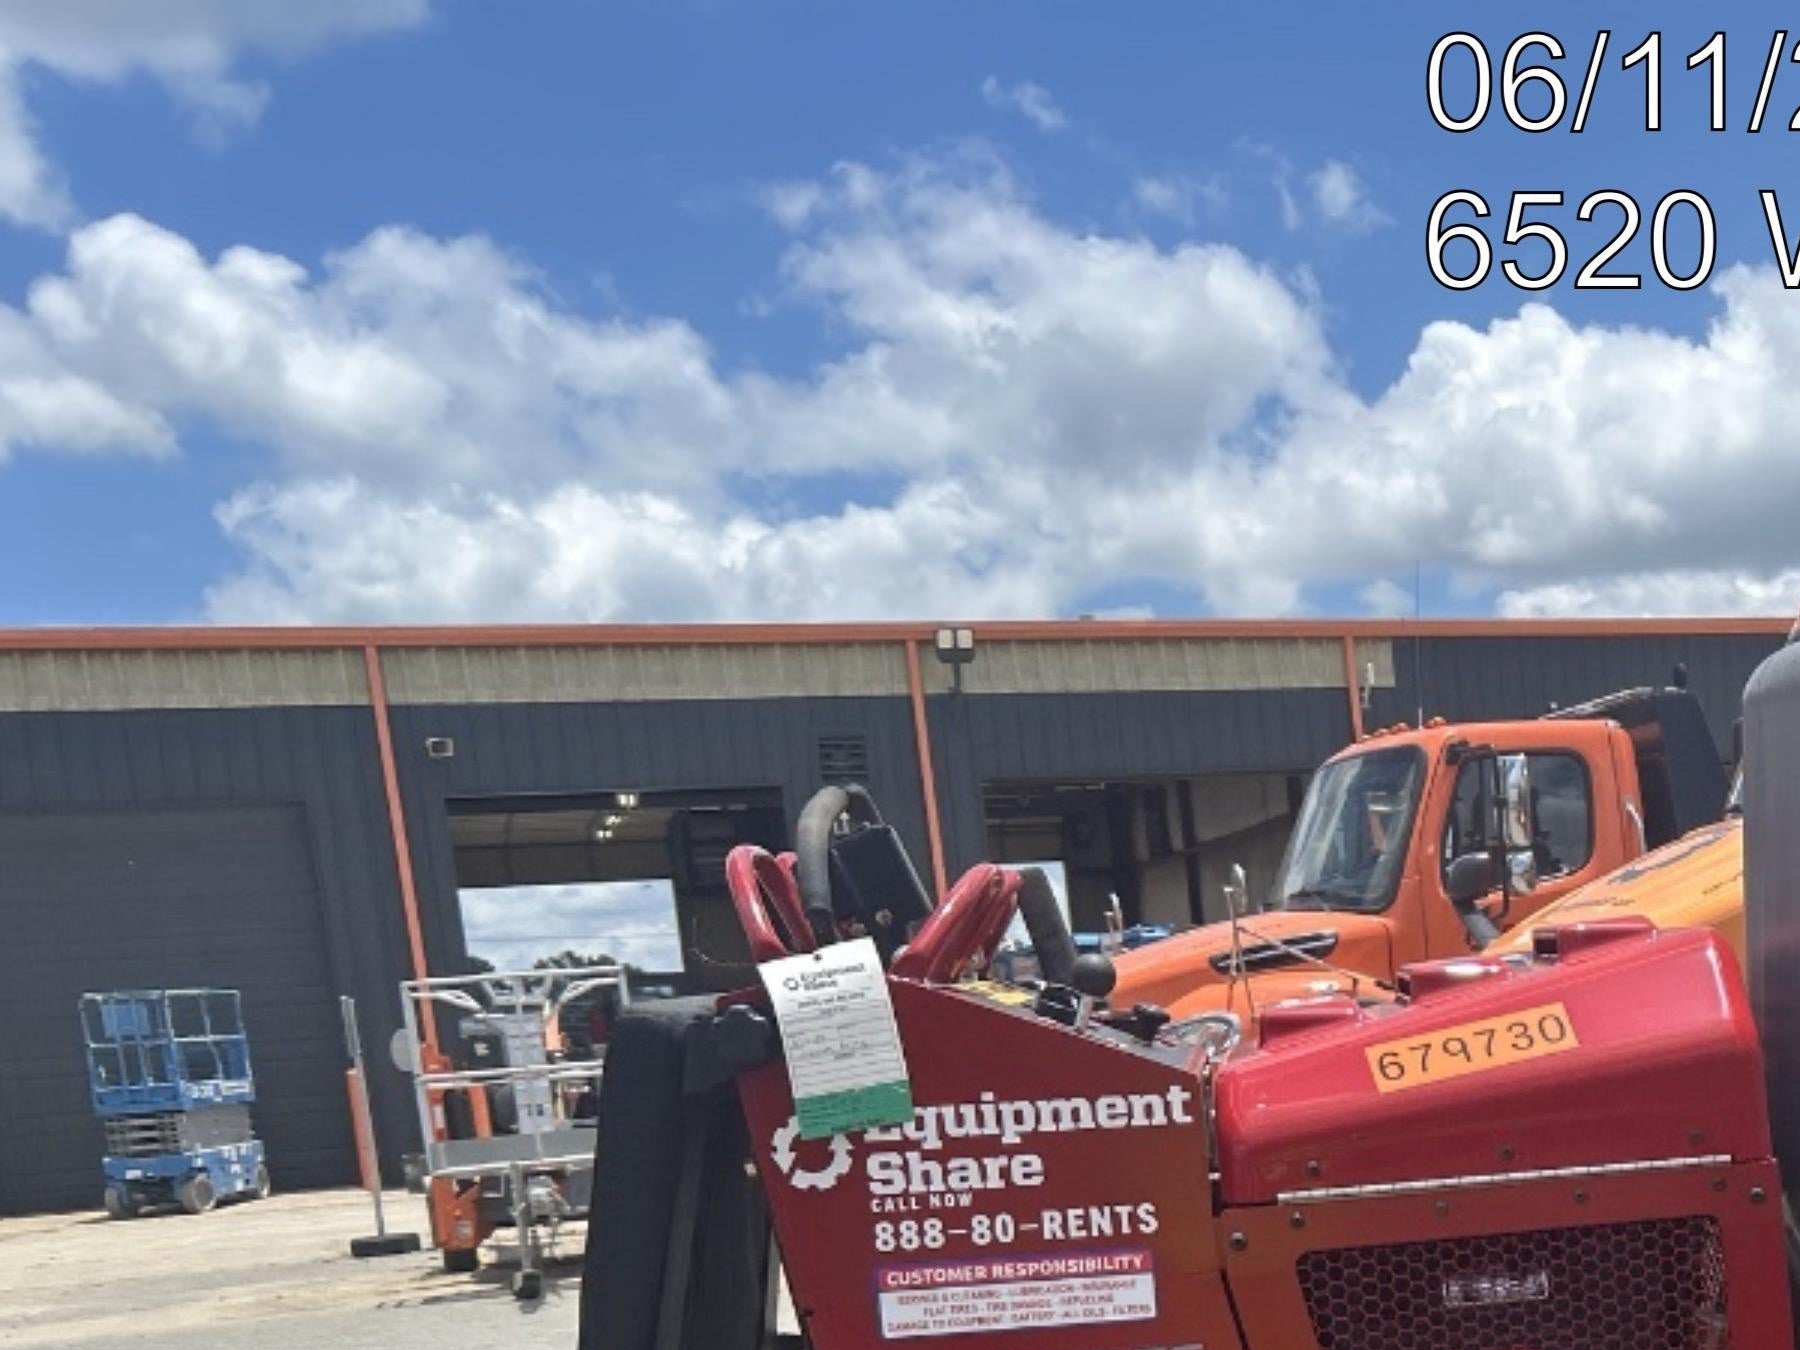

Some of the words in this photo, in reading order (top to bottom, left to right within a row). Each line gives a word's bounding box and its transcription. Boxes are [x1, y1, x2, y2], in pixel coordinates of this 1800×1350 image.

[1377, 1013, 1567, 1081] 679730
[865, 1150, 1045, 1196] Share
[871, 1195, 921, 1213] CALL
[929, 1192, 974, 1208] NOW
[874, 1201, 1160, 1252] 888-80-RENTS
[887, 1264, 987, 1286] CUSTOMER
[991, 1254, 1145, 1279] RESPONSIBILITY
